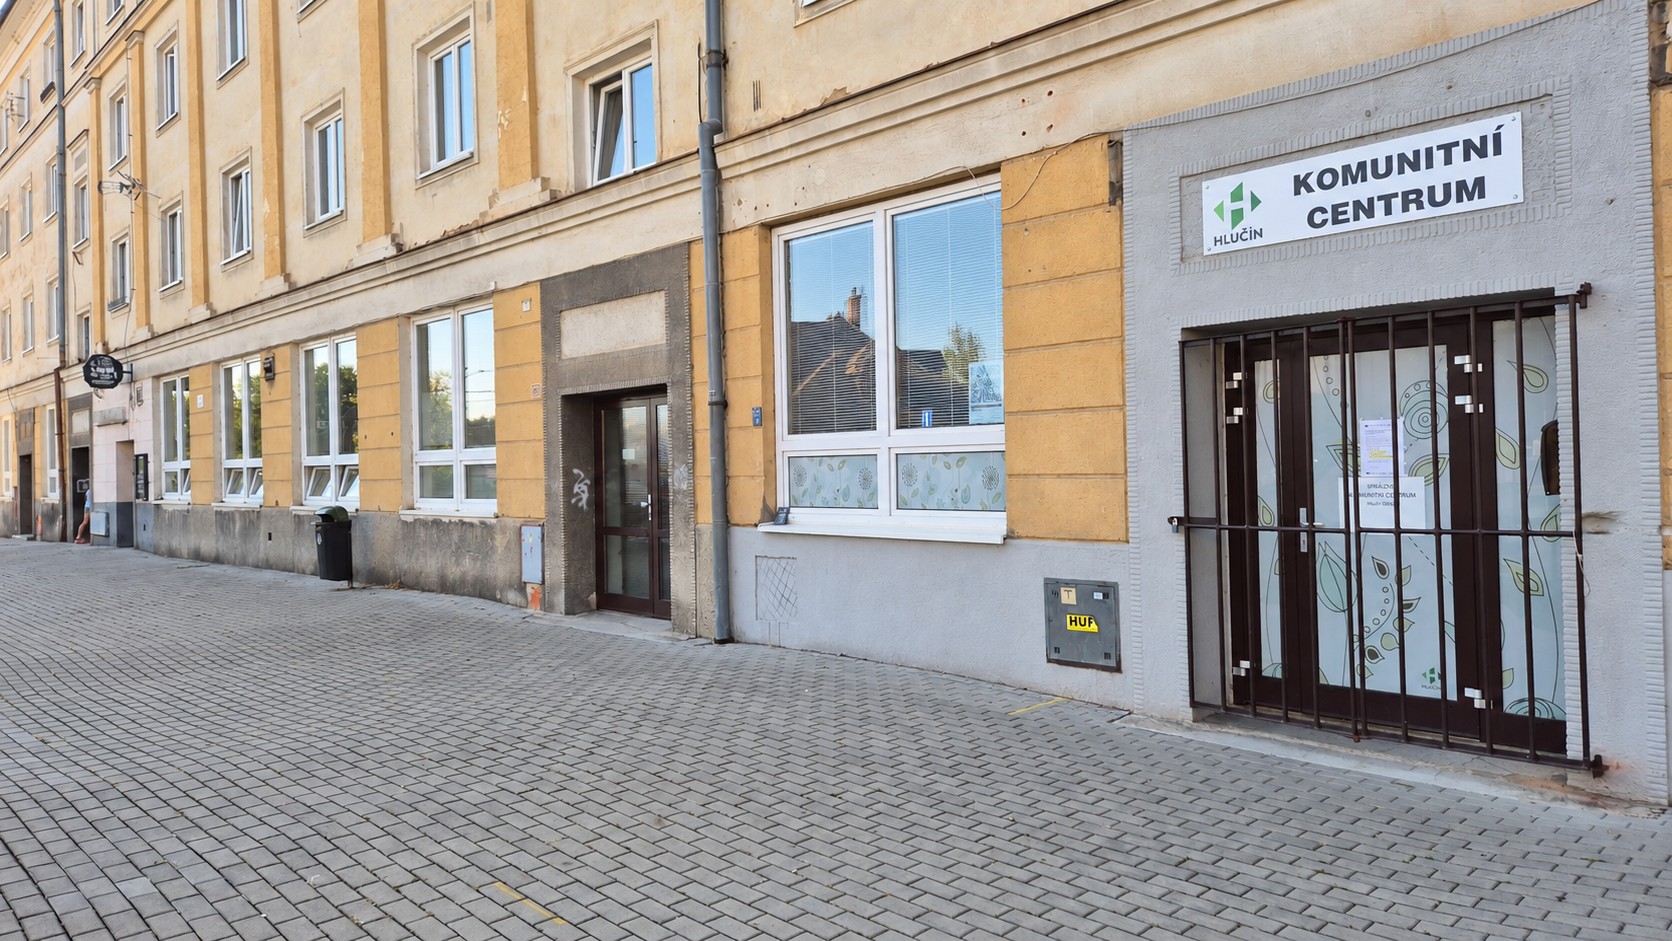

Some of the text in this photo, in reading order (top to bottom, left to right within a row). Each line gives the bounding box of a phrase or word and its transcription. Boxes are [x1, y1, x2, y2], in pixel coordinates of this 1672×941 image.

[1293, 124, 1505, 196] KOMUNITNÍ
[1306, 176, 1486, 228] CENTRUM
[1213, 226, 1263, 246] HLUČÍN
[1064, 590, 1073, 599] T
